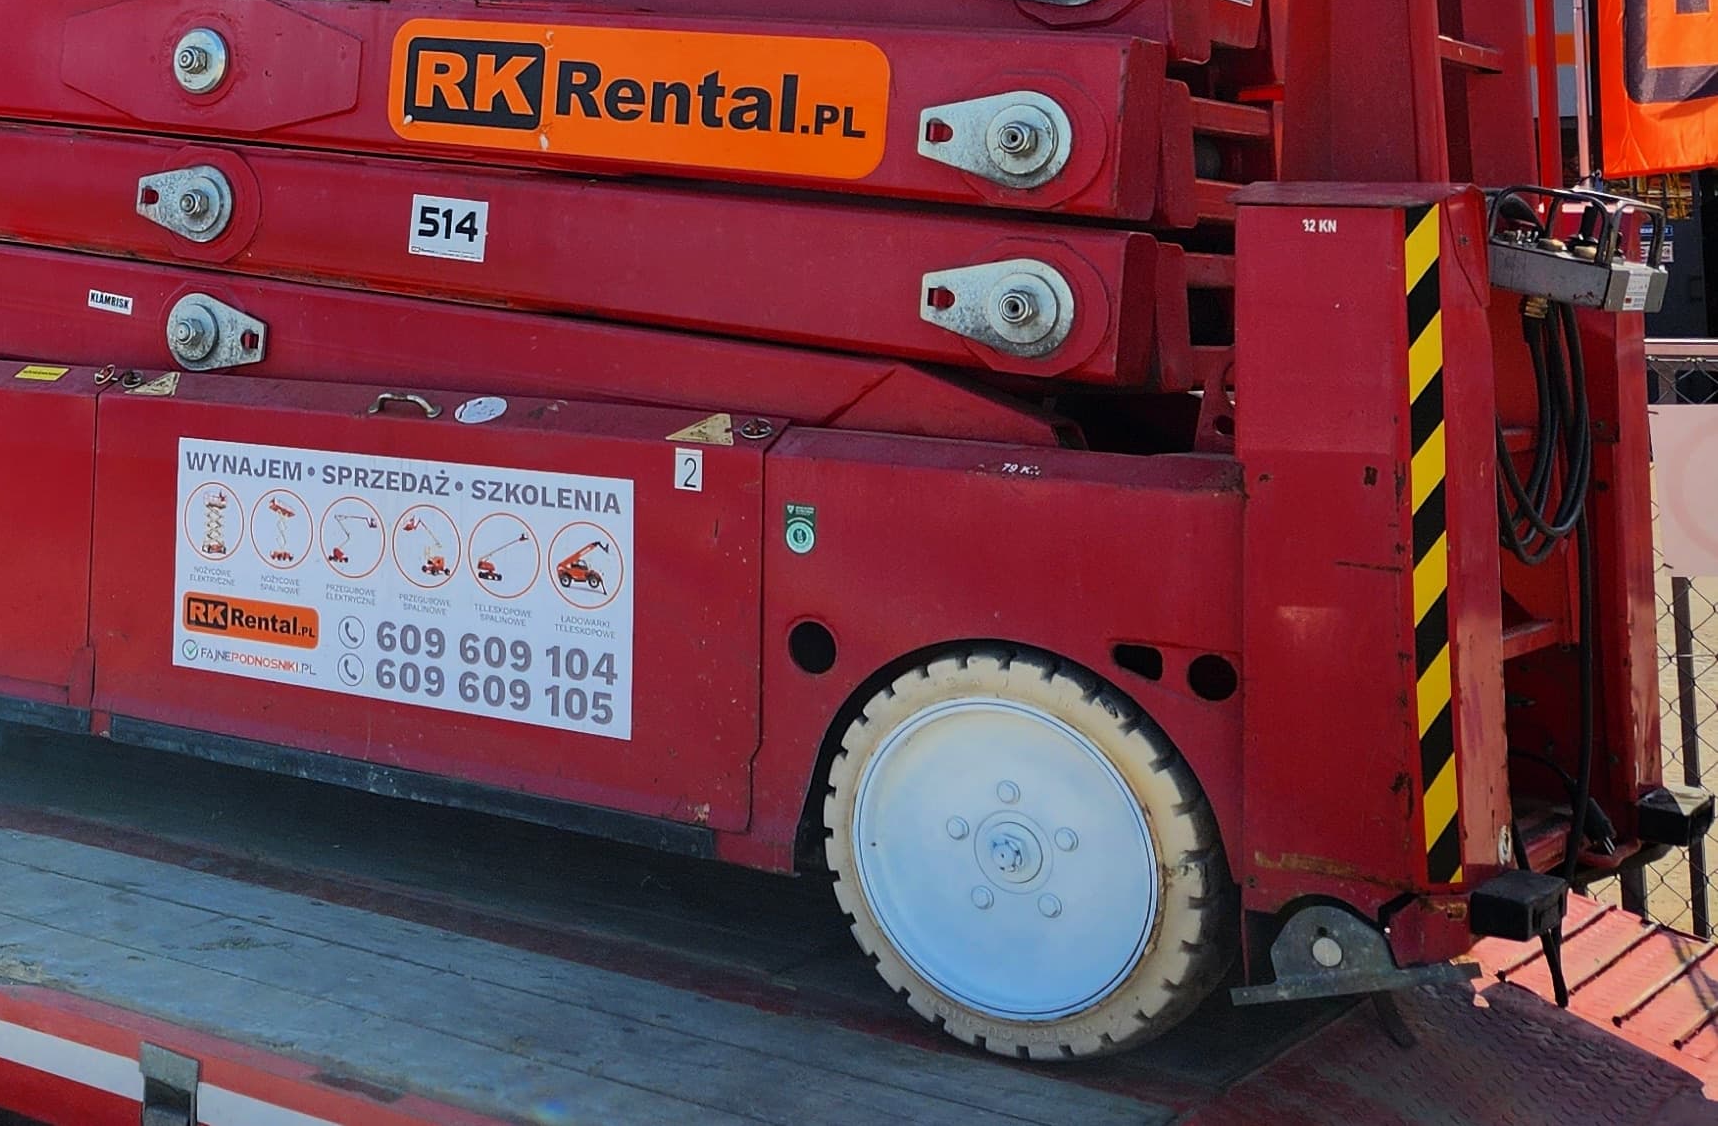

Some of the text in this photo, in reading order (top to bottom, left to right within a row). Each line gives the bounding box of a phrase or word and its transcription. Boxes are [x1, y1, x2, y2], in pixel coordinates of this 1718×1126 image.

[415, 50, 866, 140] RK Rental.PL
[418, 205, 479, 243] 514
[186, 451, 622, 515] WYNAJEM SPRZEDAŻ SZKOLENIA
[683, 457, 697, 488] 2
[189, 600, 316, 638] RK Rental.PL
[200, 647, 317, 676] FAJNEPODNOSNIKI.PL
[376, 621, 618, 685] 609 609 104
[375, 658, 614, 725] 609 609 105
